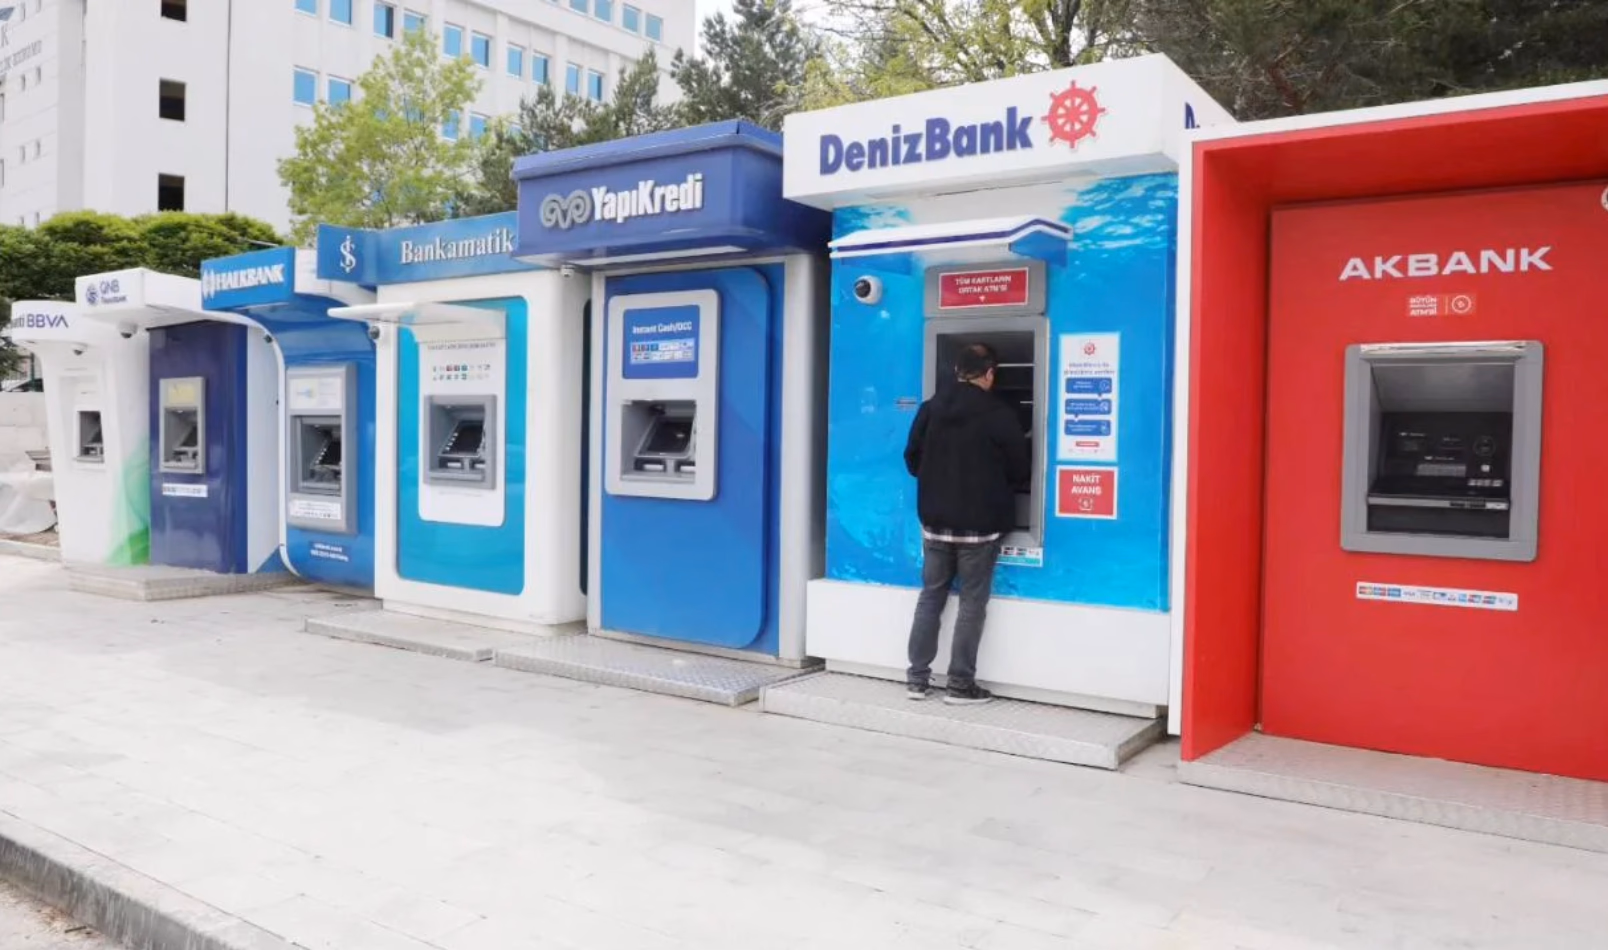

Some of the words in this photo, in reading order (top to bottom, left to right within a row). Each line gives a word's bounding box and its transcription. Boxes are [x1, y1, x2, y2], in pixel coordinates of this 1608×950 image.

[820, 106, 1034, 175] DenizBank
[591, 173, 703, 223] YapıKredi
[402, 227, 515, 264] Bankamatik
[214, 263, 285, 292] HALKBANK
[1338, 246, 1553, 280] AKBANK
[100, 279, 121, 294] QNB
[26, 313, 69, 328] BBVA
[1071, 486, 1102, 495] AVANS
